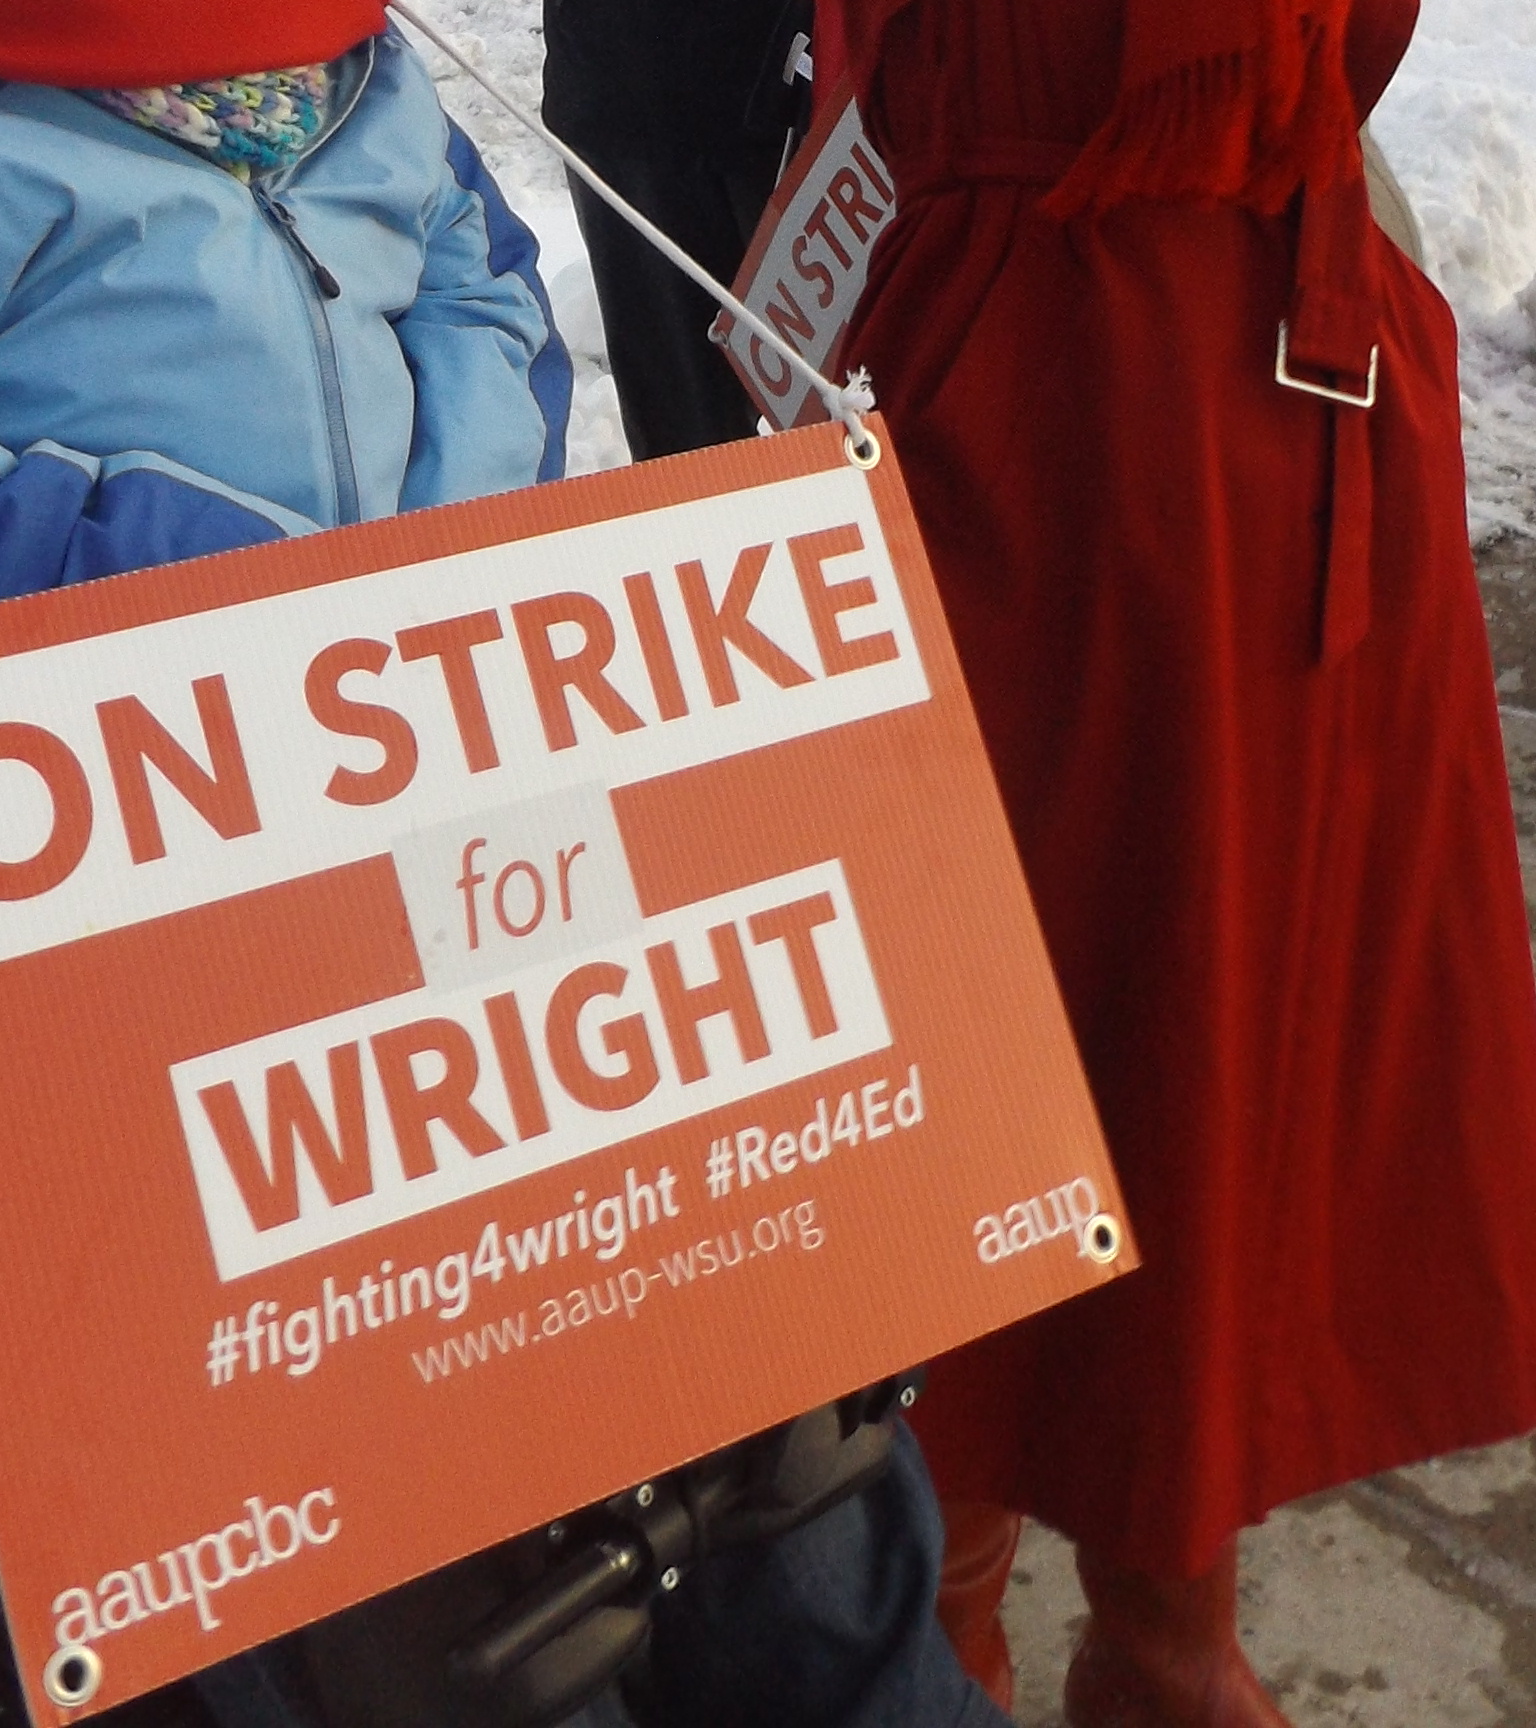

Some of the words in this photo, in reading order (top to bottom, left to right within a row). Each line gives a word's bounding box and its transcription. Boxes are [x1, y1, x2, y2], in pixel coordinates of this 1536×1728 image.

[303, 522, 901, 807] STRIKE
[454, 834, 586, 952] for
[198, 891, 839, 1235] WRIGHT
[205, 1164, 681, 1387] #fighting4wright
[706, 1065, 927, 1198] #Red4Ed
[410, 1189, 827, 1387] www.aaup-wsu.org
[972, 1176, 1101, 1264] aaup
